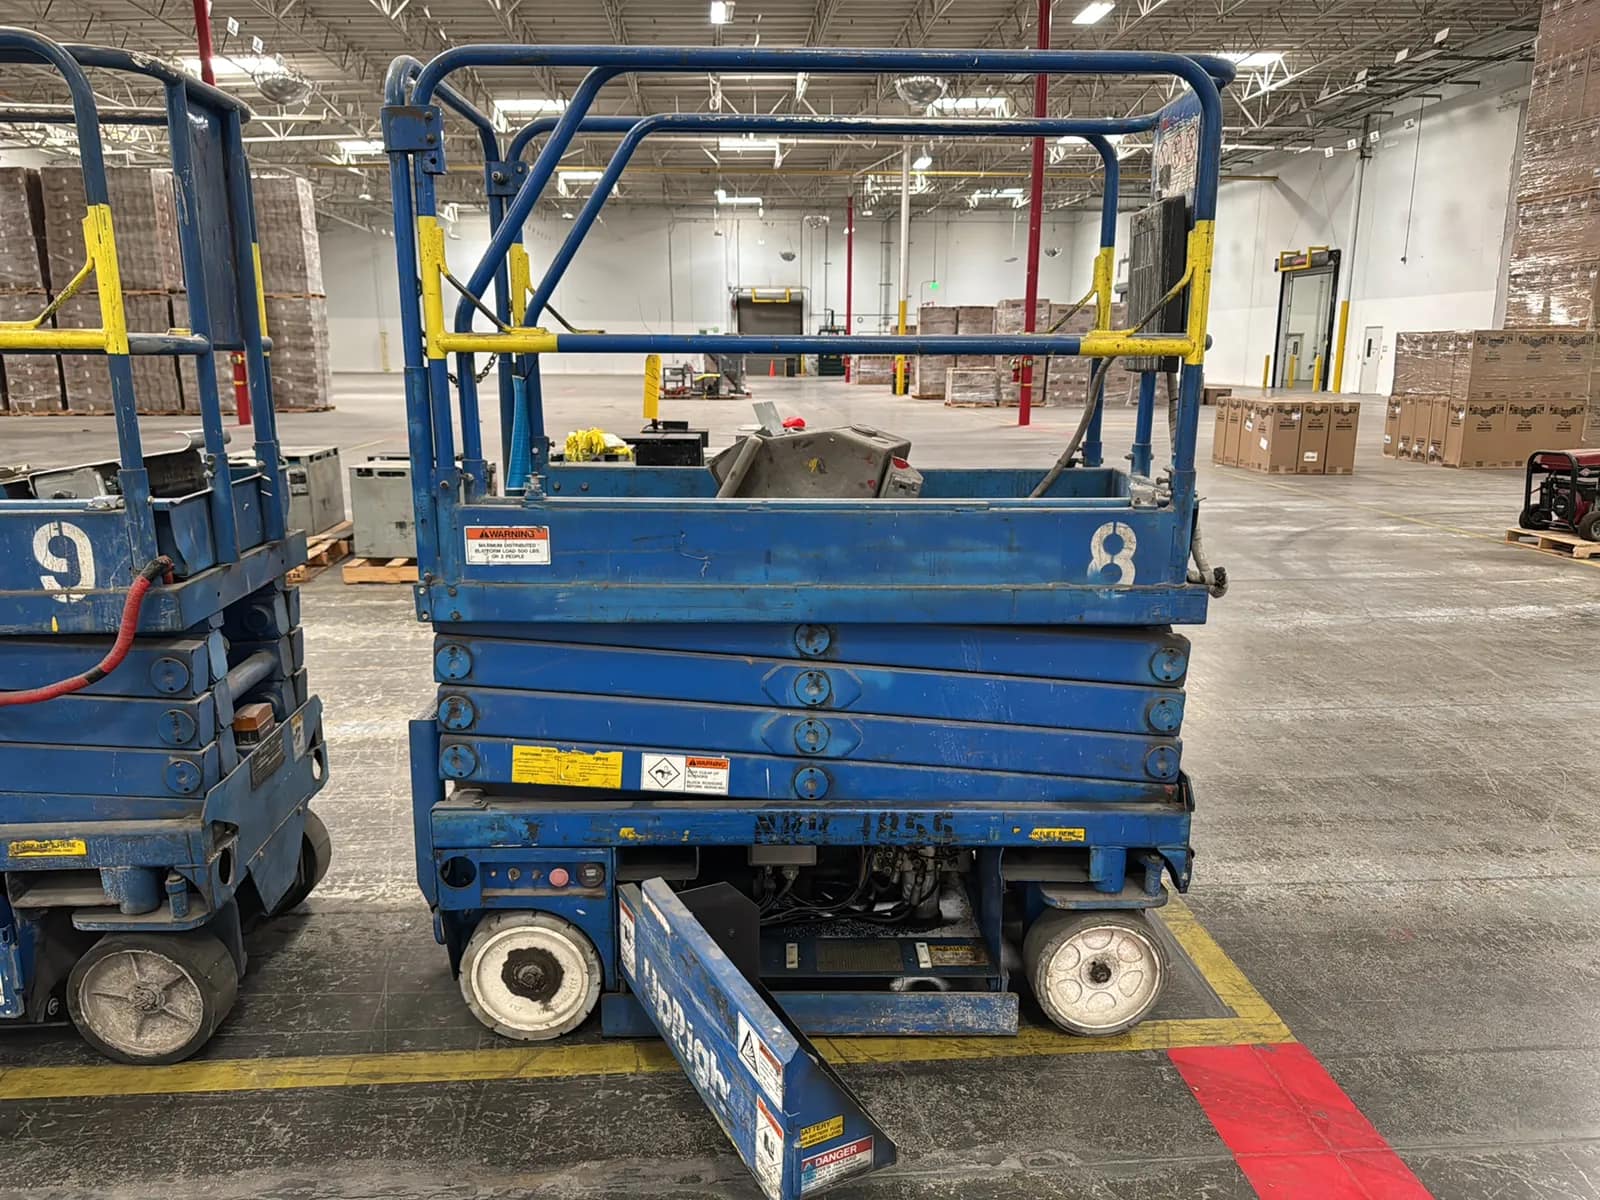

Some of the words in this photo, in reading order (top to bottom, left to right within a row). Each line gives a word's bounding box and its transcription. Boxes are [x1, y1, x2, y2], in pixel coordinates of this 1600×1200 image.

[490, 530, 535, 538] WARNING
[33, 522, 96, 603] 9
[1087, 521, 1137, 598] 8
[815, 1145, 858, 1167] DANGER
